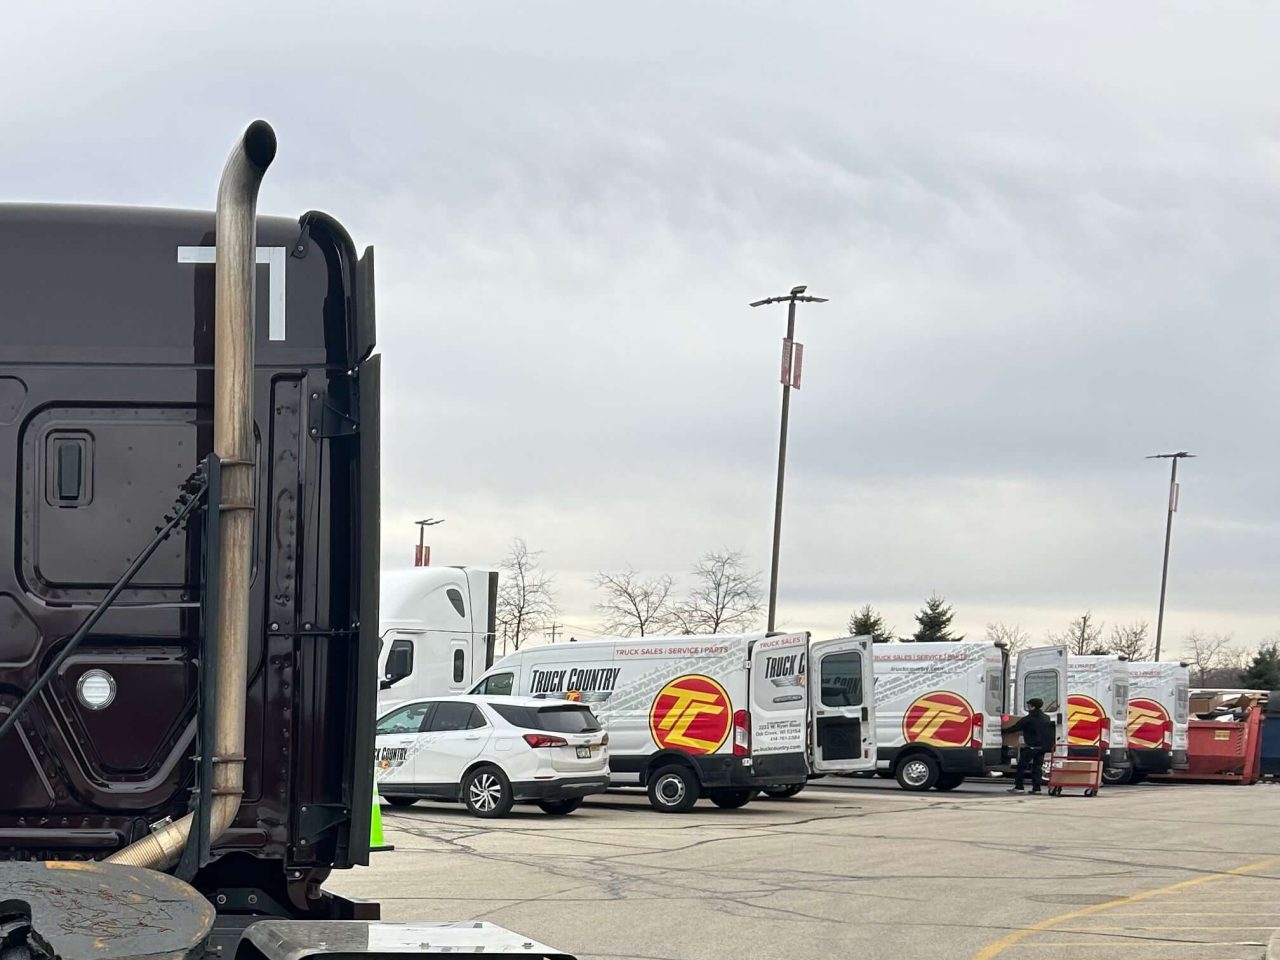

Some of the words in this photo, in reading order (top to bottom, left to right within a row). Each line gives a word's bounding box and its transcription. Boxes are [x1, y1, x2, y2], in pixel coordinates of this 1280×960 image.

[760, 640, 780, 649] TRUCK
[782, 637, 801, 646] SALES
[668, 647, 699, 655] SERVICE
[704, 646, 729, 654] PARTS
[765, 654, 798, 679] TRUCK
[530, 669, 567, 693] TRUCK
[567, 667, 621, 692] COUNTRY
[381, 747, 408, 761] COUNTRY
